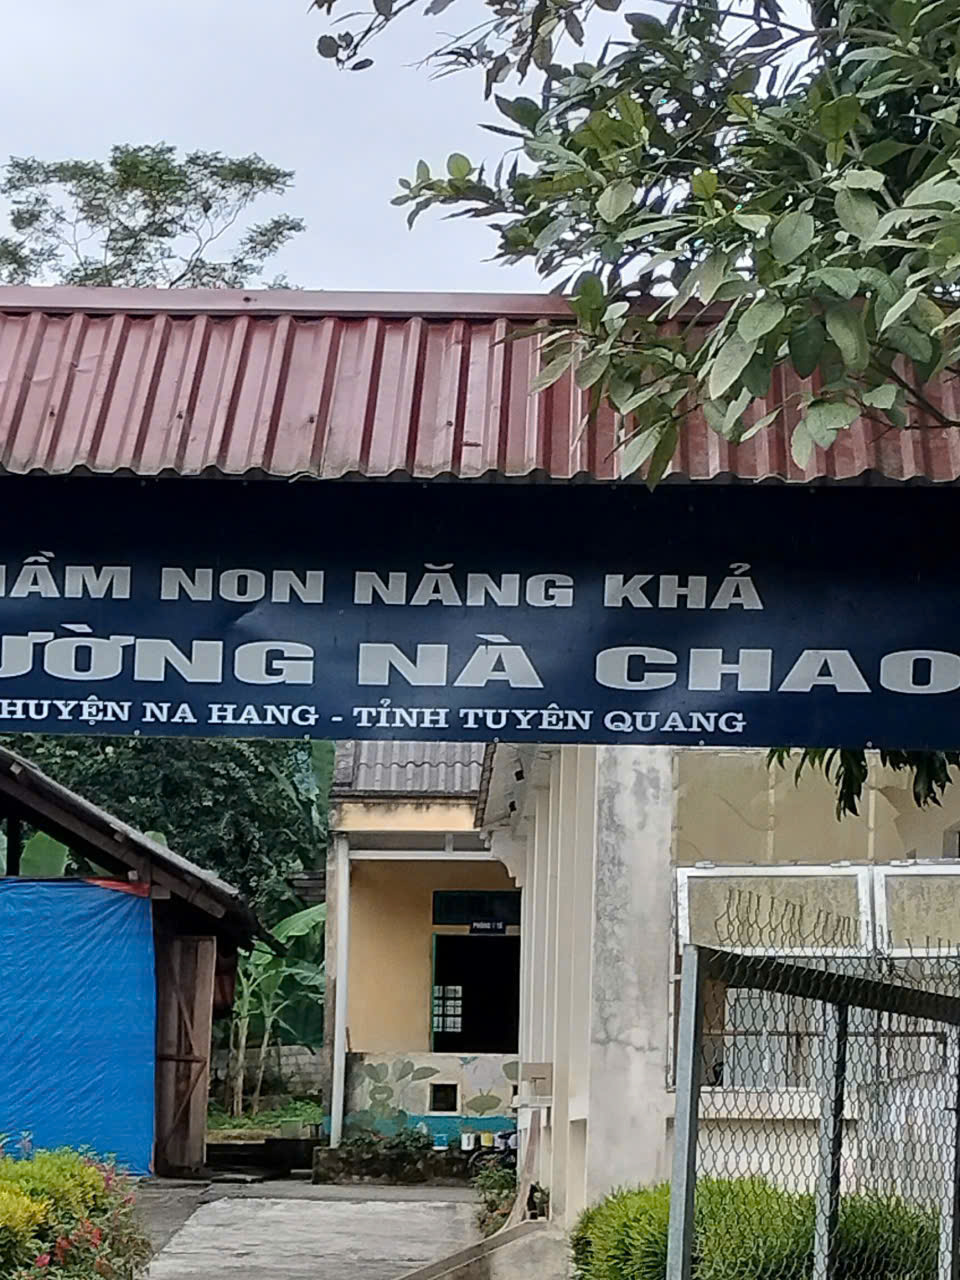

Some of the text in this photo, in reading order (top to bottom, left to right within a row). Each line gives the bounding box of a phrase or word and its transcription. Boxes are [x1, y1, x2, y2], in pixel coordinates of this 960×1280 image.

[160, 567, 324, 603] NON
[354, 563, 574, 607] NĂNG
[603, 563, 764, 610] KHẢ
[357, 633, 545, 688] NÀ
[595, 646, 960, 694] CHAO
[141, 702, 197, 723] NA
[207, 704, 319, 726] HANG
[352, 697, 450, 728] TỈNH
[458, 703, 593, 731] TUYÊN
[604, 711, 746, 733] QUANG
